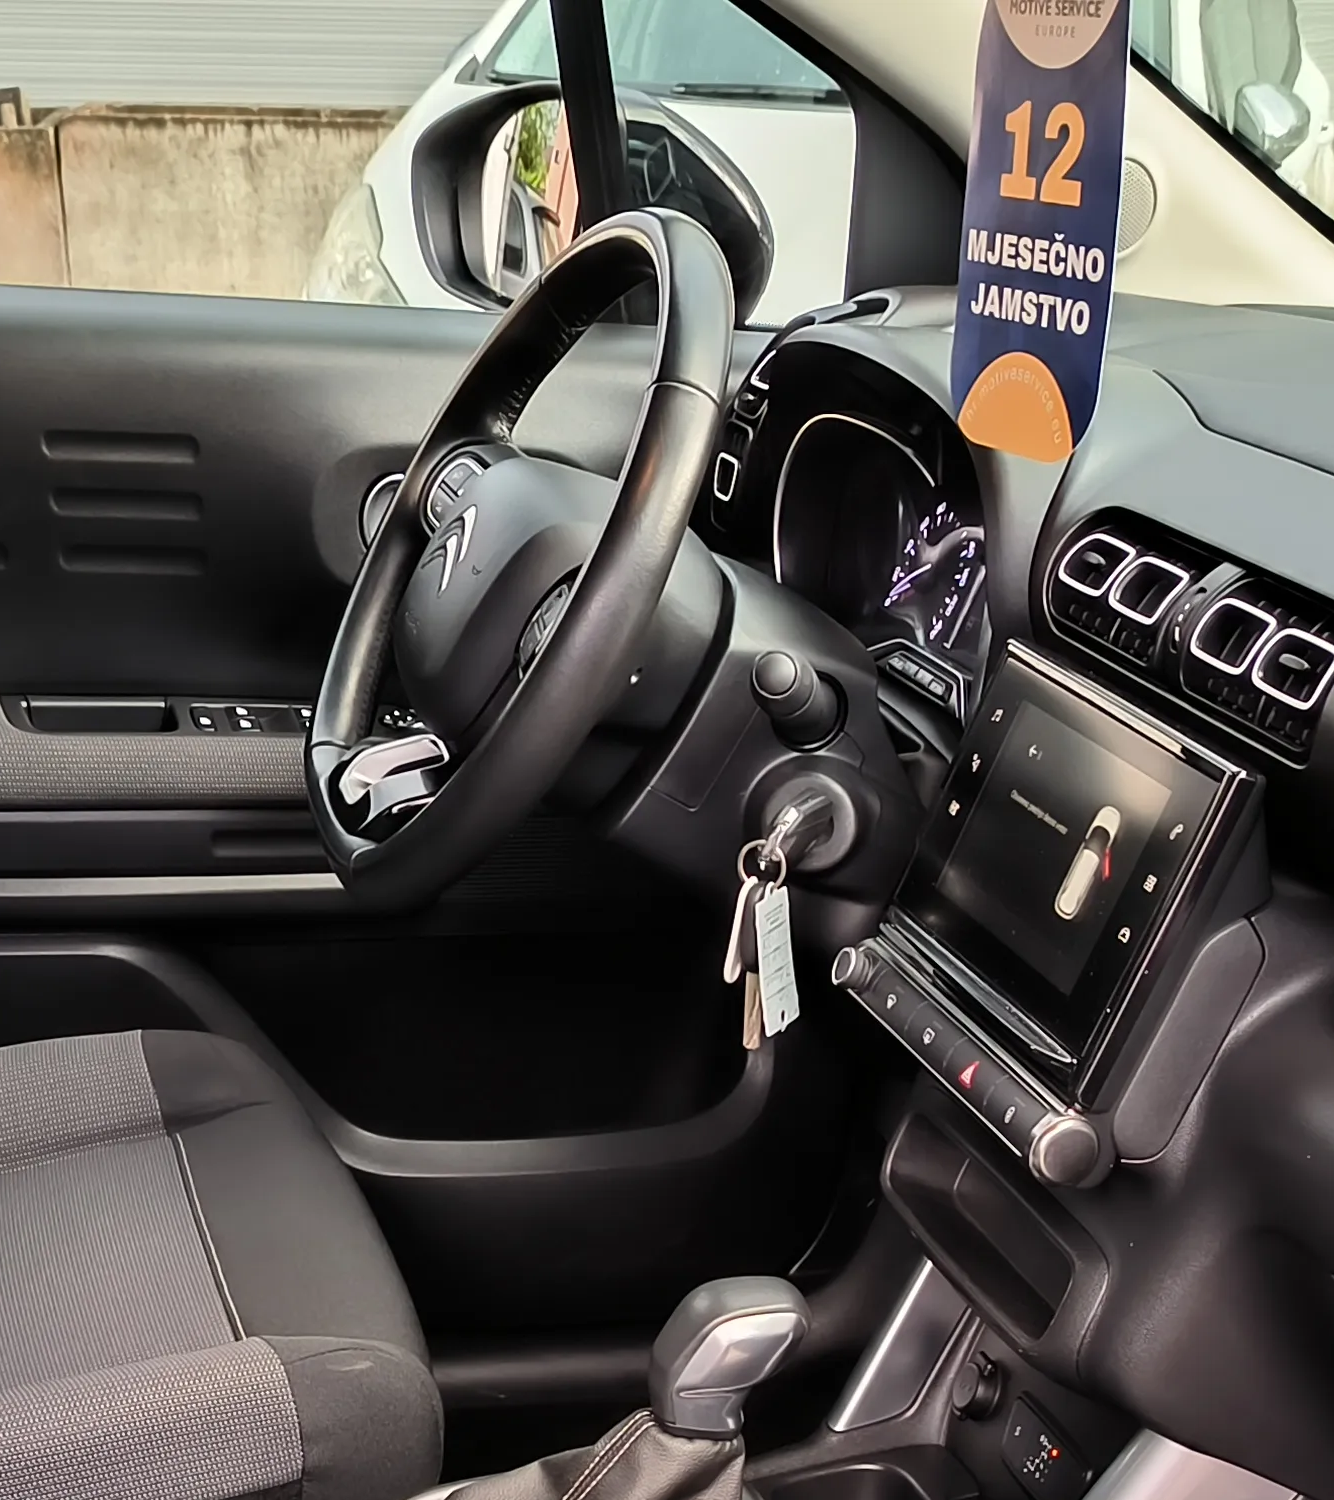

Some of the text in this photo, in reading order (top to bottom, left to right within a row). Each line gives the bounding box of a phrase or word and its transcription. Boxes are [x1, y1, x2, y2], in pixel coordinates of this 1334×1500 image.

[1009, 0, 1103, 18] MOTIVE SERVICE
[1035, 24, 1076, 39] EUROPE
[1000, 100, 1085, 207] 12
[967, 228, 1105, 283] MJESEČNO
[970, 283, 1090, 335] JAMSTVO
